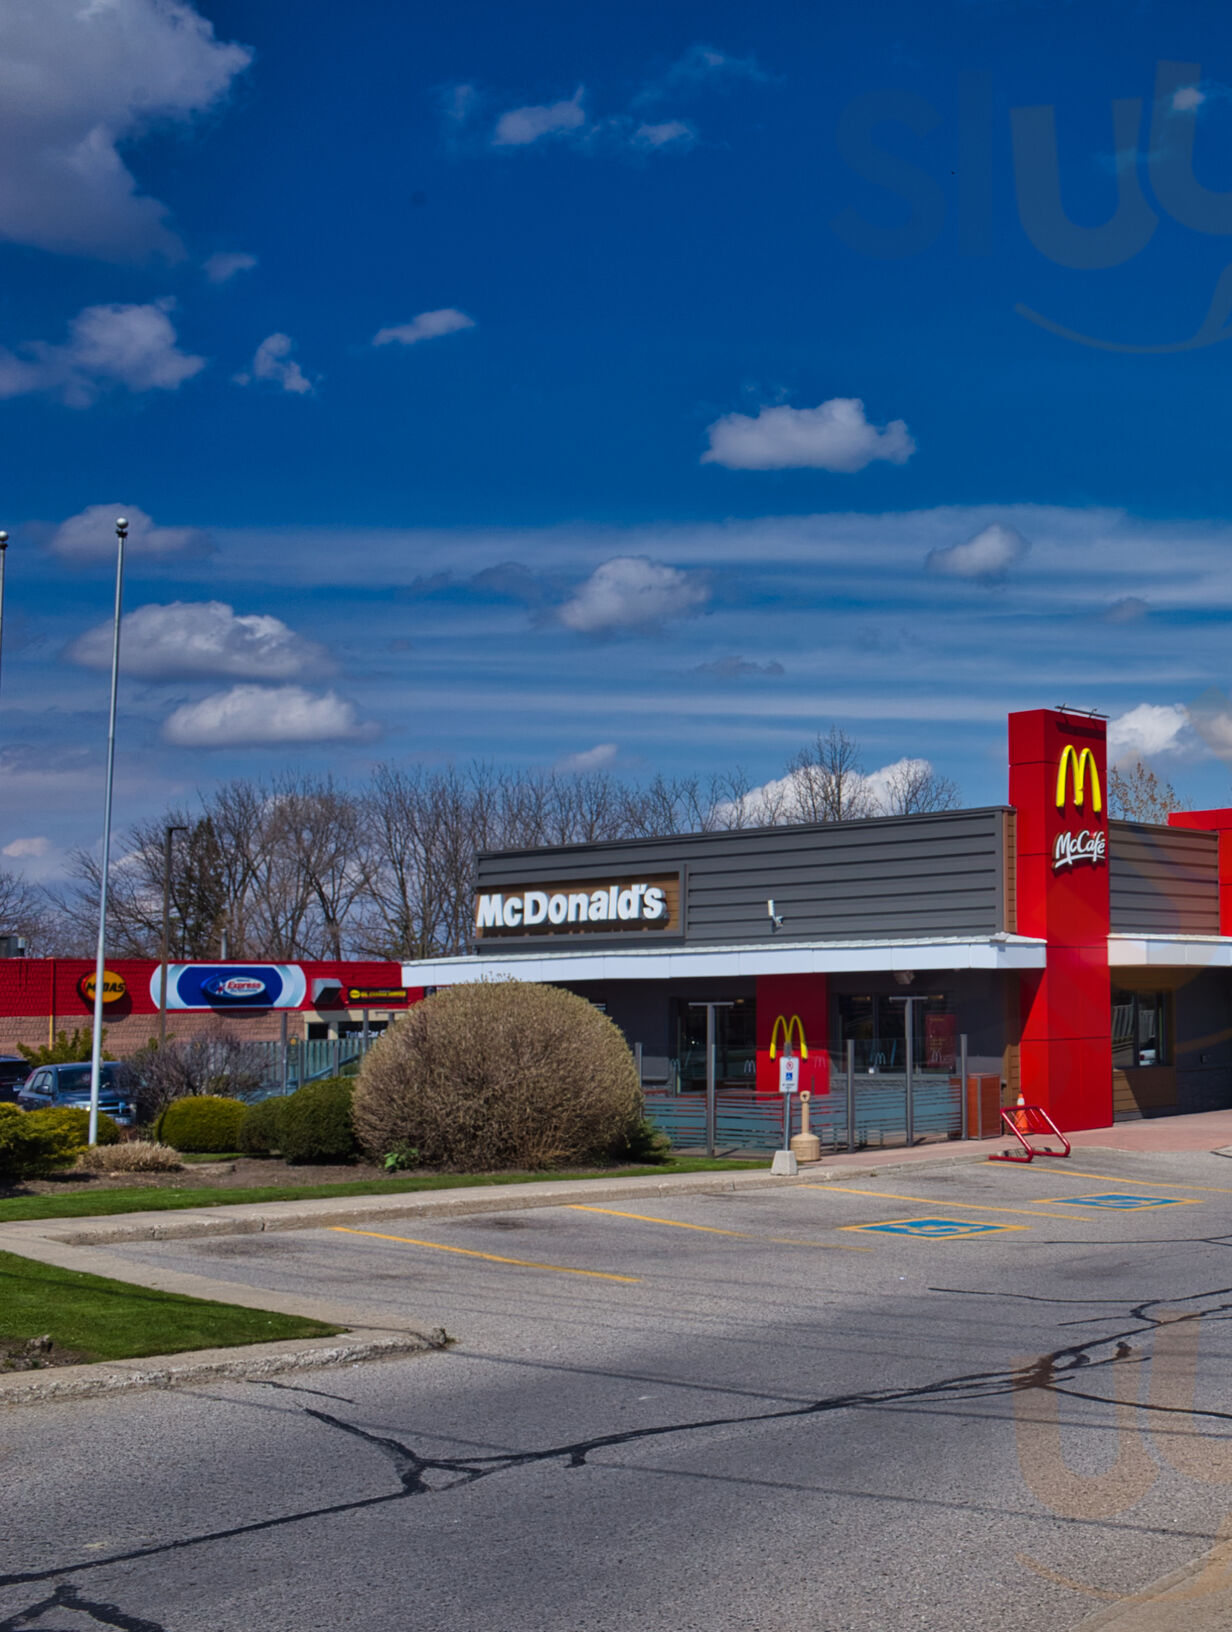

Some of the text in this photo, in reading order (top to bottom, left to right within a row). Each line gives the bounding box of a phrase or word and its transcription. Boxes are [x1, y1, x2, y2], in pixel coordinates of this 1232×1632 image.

[476, 884, 666, 928] McDonald's
[86, 982, 126, 993] MDAS
[227, 981, 262, 990] Express
